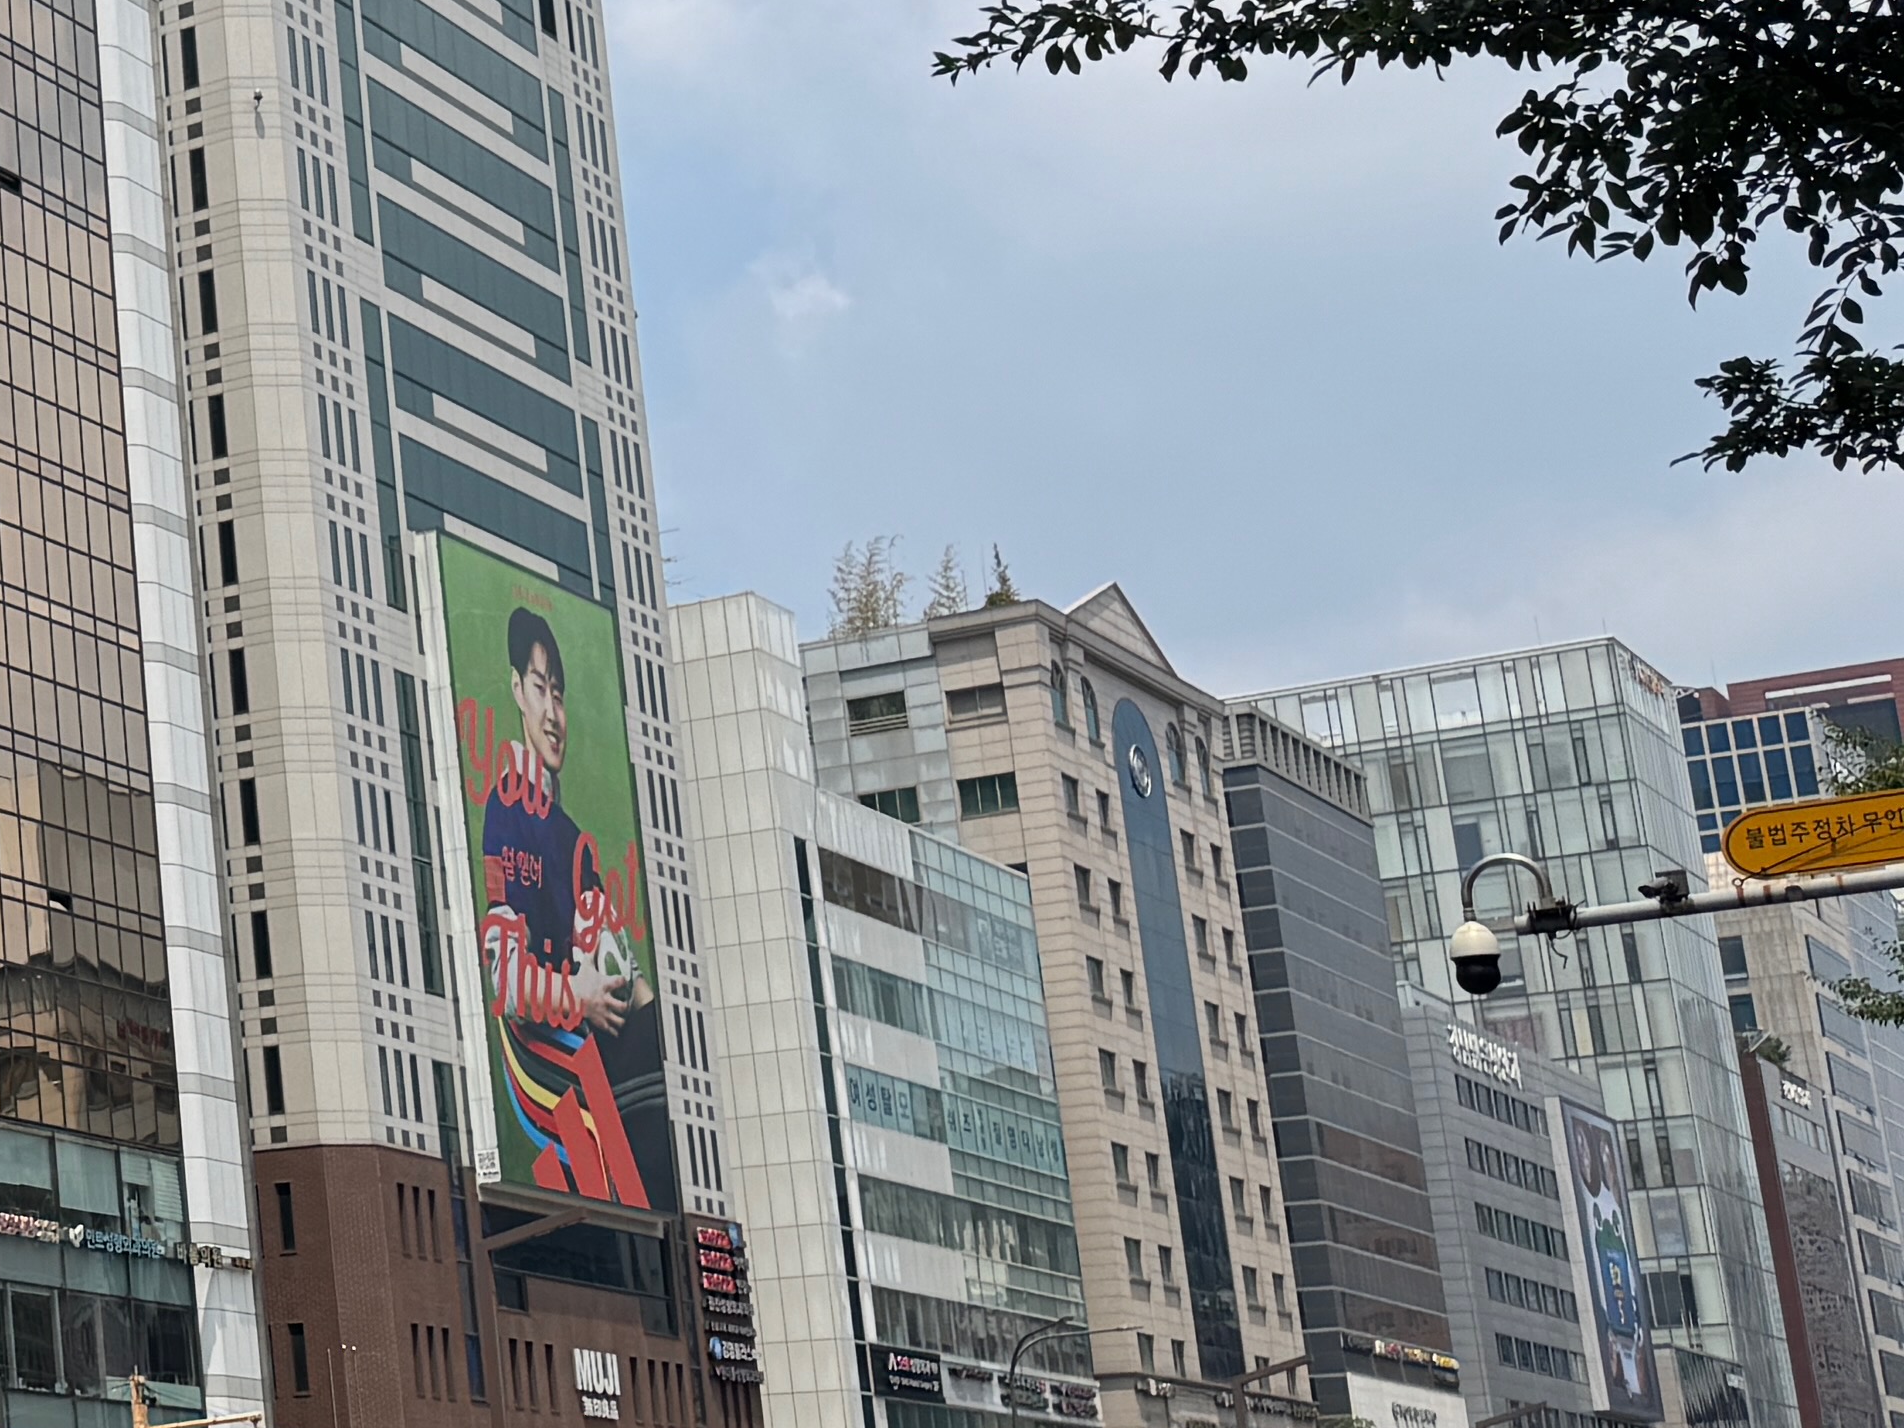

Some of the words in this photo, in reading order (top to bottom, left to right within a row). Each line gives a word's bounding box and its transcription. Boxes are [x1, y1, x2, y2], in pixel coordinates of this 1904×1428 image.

[456, 694, 553, 822] You
[1745, 813, 1855, 851] 불법주정차
[572, 829, 646, 954] Got
[478, 909, 585, 1031] This
[848, 1076, 910, 1120] 여성탈모
[573, 1347, 622, 1396] MUJI
